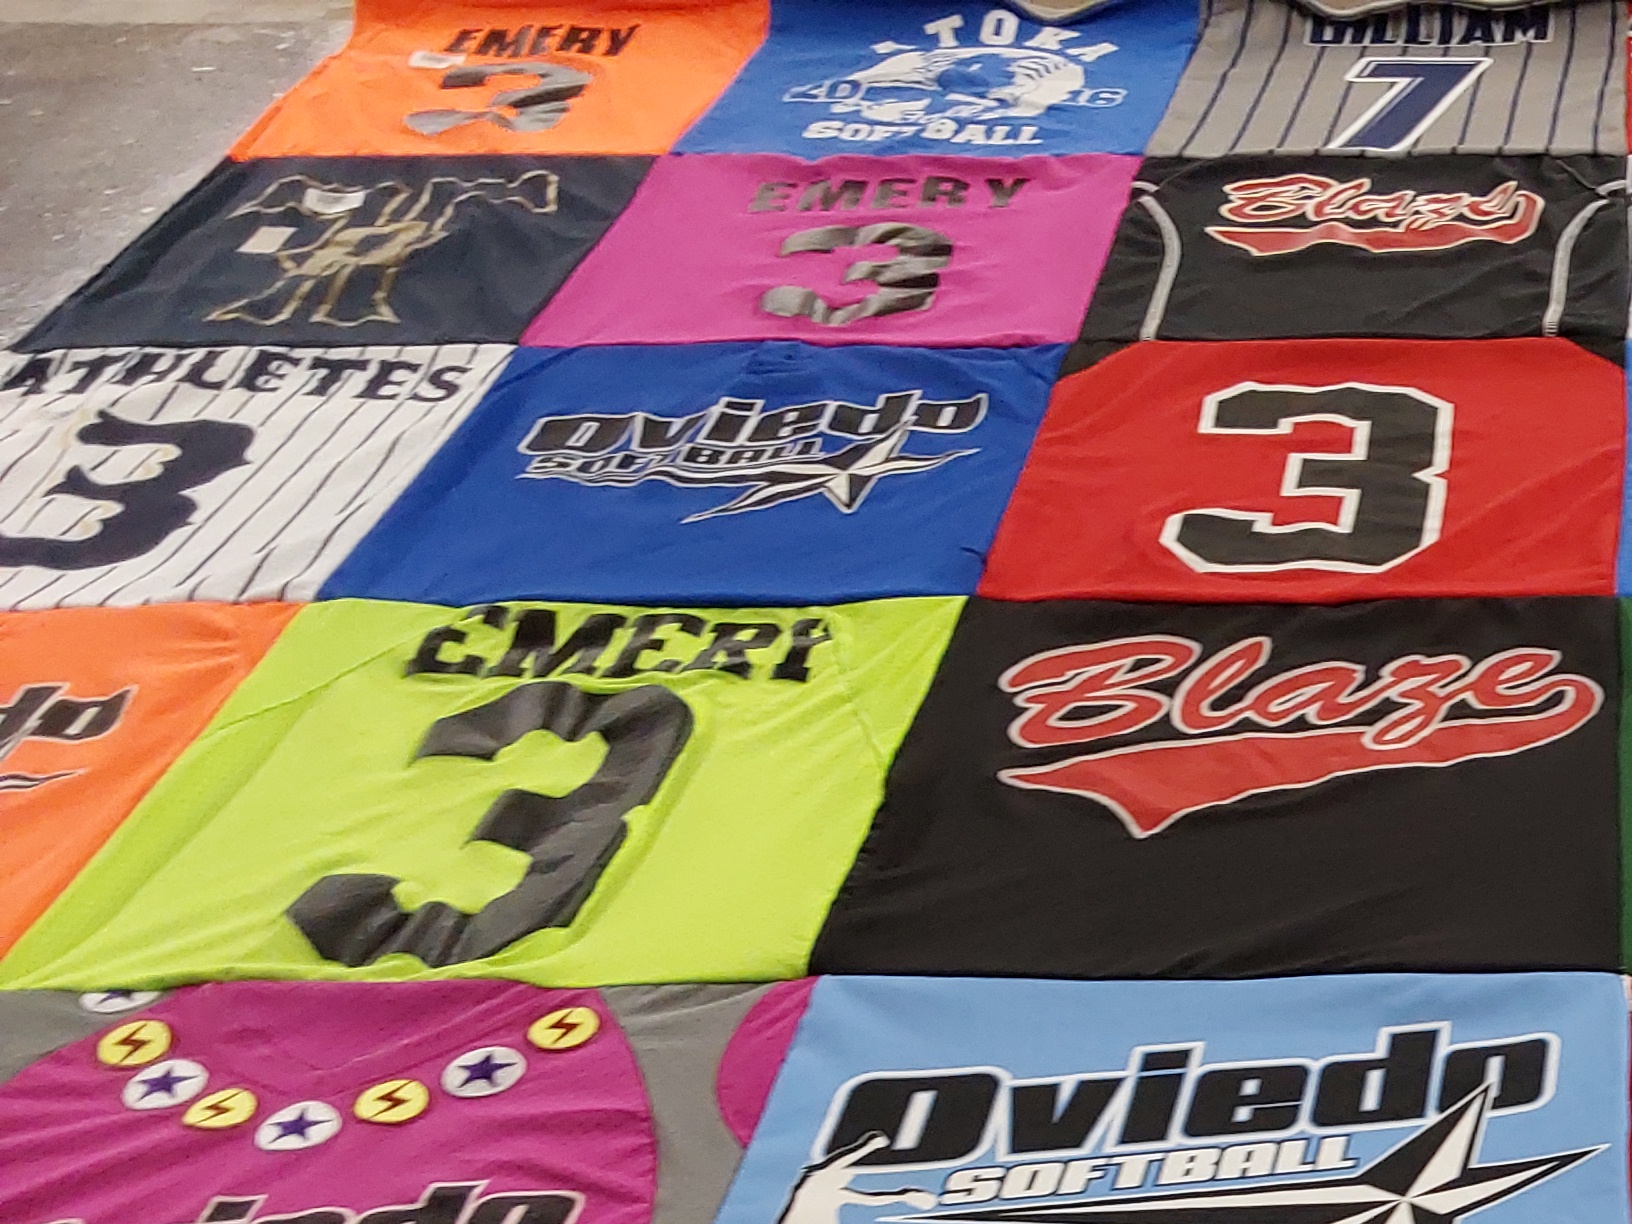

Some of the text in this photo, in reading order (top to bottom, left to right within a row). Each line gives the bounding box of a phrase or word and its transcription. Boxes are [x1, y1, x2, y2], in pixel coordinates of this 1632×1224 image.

[1327, 56, 1494, 151] 7
[749, 175, 1031, 212] EMERY
[759, 221, 955, 328] 3
[0, 347, 473, 402] ATHLETES
[517, 389, 990, 454] Oviedo
[0, 407, 256, 571] 3
[1159, 381, 1455, 574] 3
[998, 634, 1606, 752] Blaze
[285, 680, 695, 969] 3
[810, 1020, 1562, 1171] Oviedo
[937, 1134, 1360, 1206] SOFTBALL
